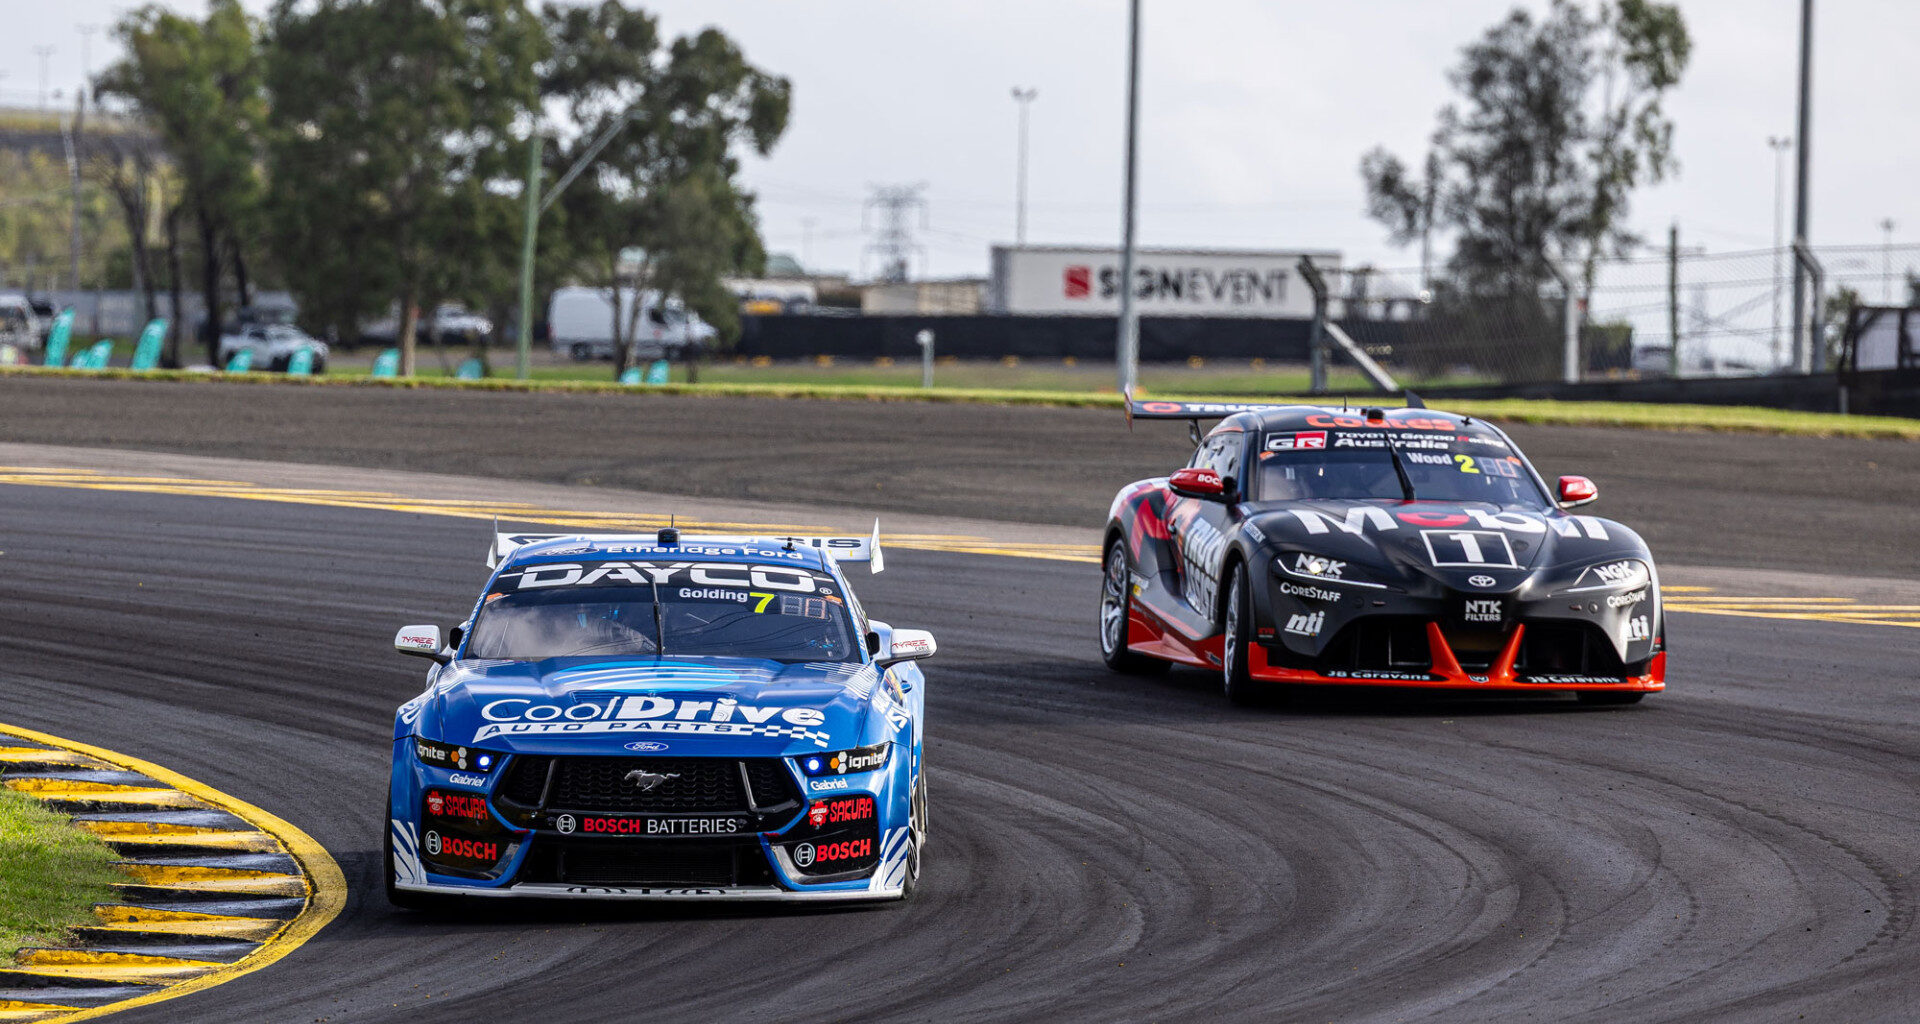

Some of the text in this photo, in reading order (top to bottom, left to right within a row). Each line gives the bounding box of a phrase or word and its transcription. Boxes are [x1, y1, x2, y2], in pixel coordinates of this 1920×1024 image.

[1098, 266, 1289, 303] SGNEVENT
[1268, 437, 1324, 449] GR
[1334, 438, 1449, 449] Ausralia
[1406, 452, 1480, 474] Wood 2
[1286, 506, 1610, 544] Mobil
[606, 546, 804, 560] Etheridge Ford
[1449, 532, 1485, 563] 1
[1295, 553, 1347, 575] NGK
[1593, 560, 1633, 582] NGK
[517, 562, 816, 592] DAYCO
[679, 588, 775, 613] Golding 7
[1465, 600, 1502, 614] NTK
[1285, 610, 1325, 633] nti
[1465, 613, 1502, 622] FILTERS
[1351, 670, 1431, 681] Caravans
[480, 695, 827, 727] CoolDrive
[487, 722, 734, 736] AUTO PARTS
[450, 773, 486, 787] Gabriel
[810, 778, 848, 791] Gabriel
[445, 795, 488, 820] SAKURA
[830, 797, 873, 823] SAKURA
[584, 817, 738, 834] BOSCH BATTERIES
[442, 836, 497, 860] BOSCH
[816, 838, 872, 862] BOSCH
